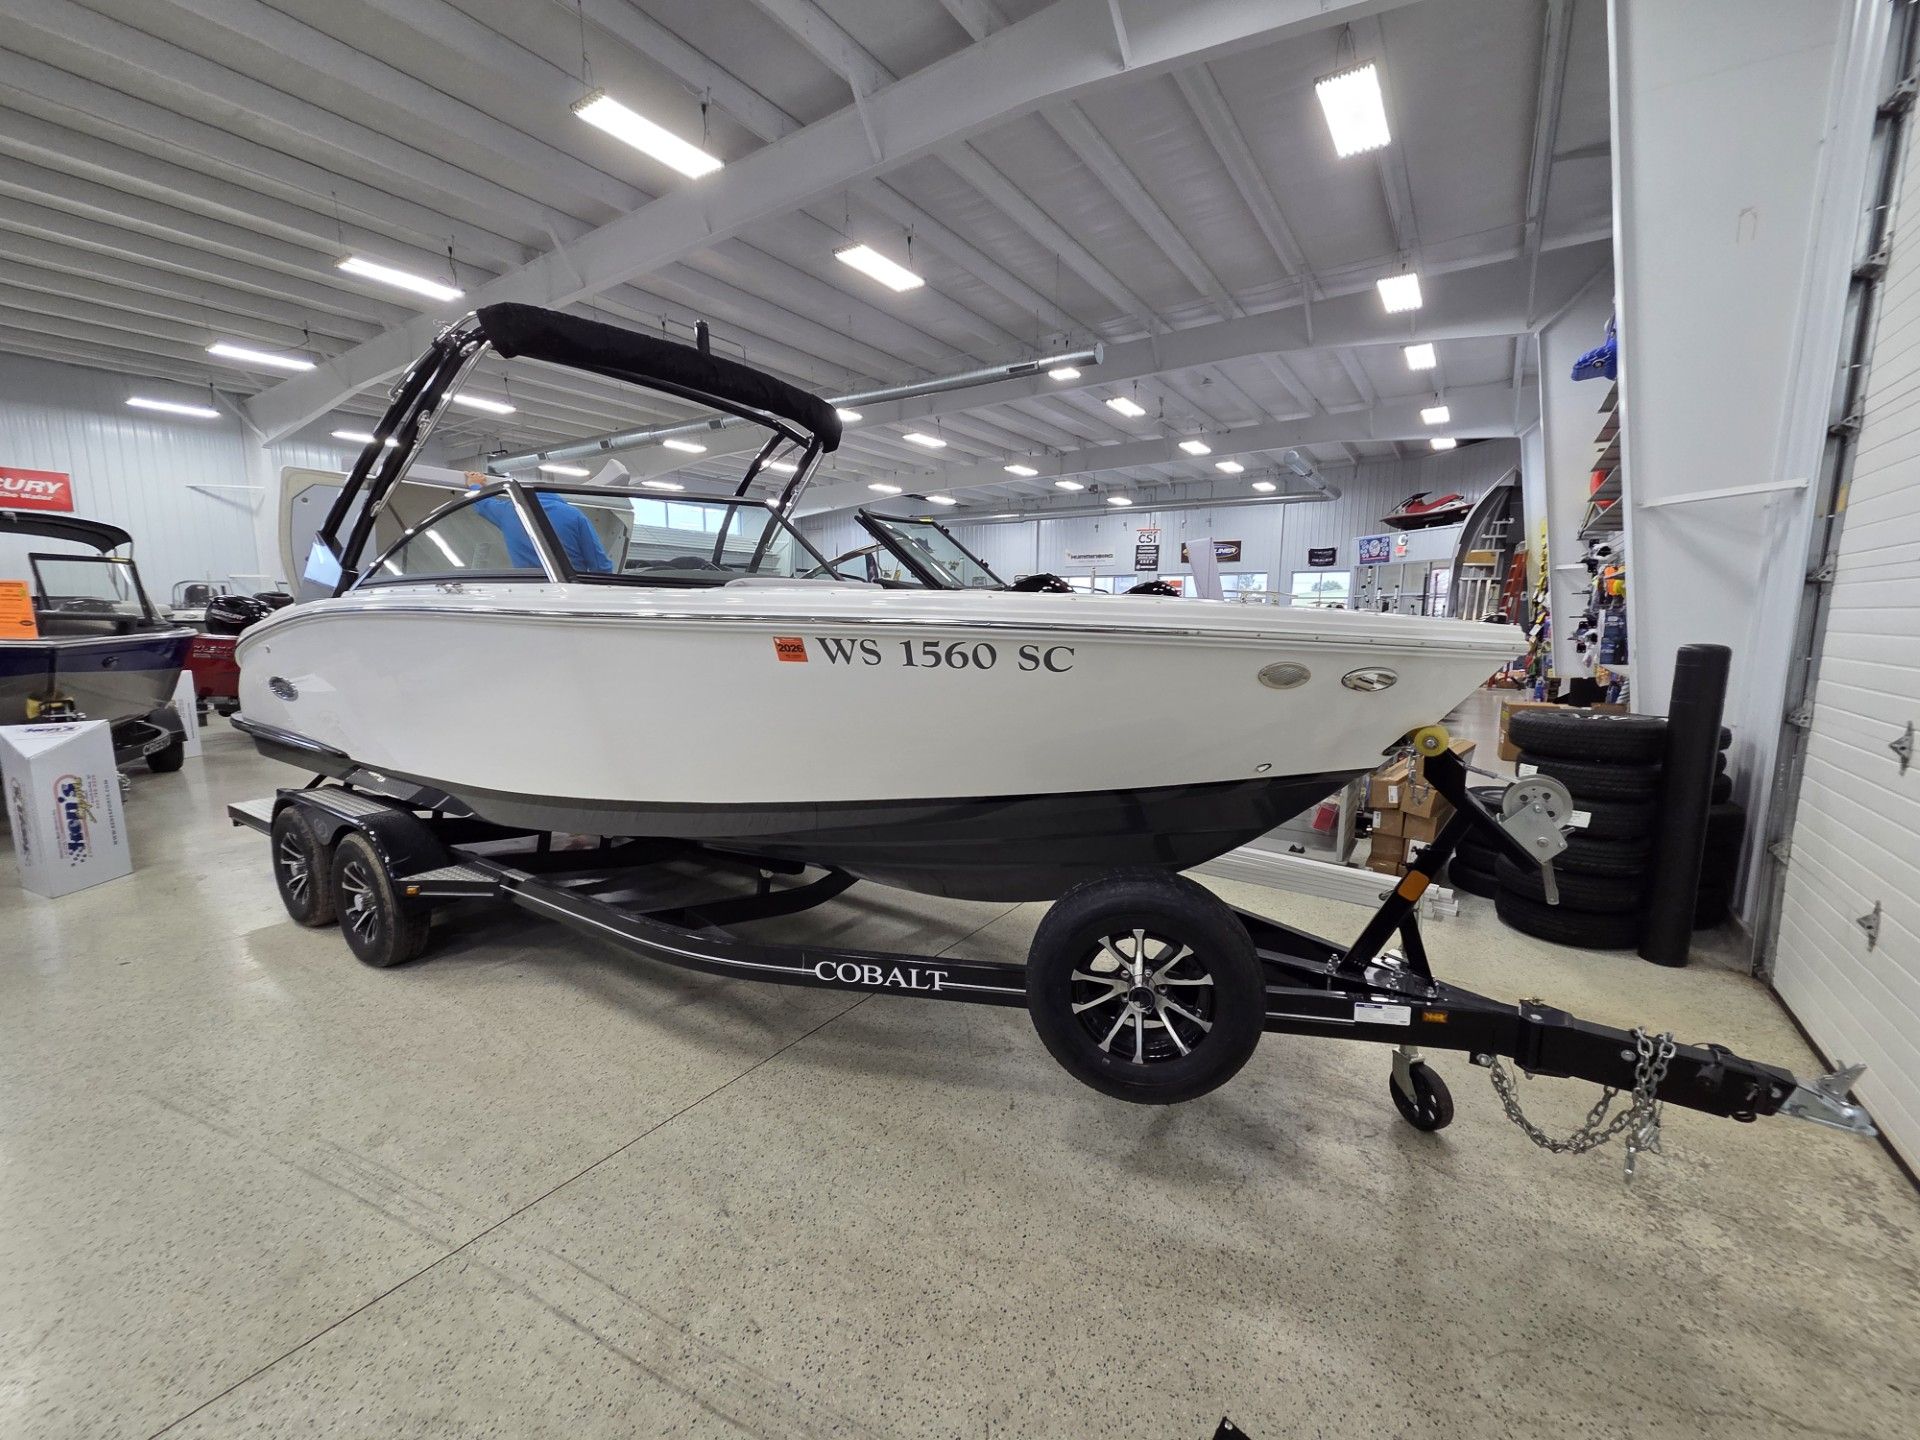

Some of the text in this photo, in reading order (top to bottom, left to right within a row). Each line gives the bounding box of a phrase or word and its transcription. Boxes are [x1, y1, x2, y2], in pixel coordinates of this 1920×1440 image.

[0, 477, 63, 494] URY
[1138, 534, 1156, 544] CSI
[815, 637, 1076, 673] WS 1560 SC
[814, 960, 949, 992] COBALT
